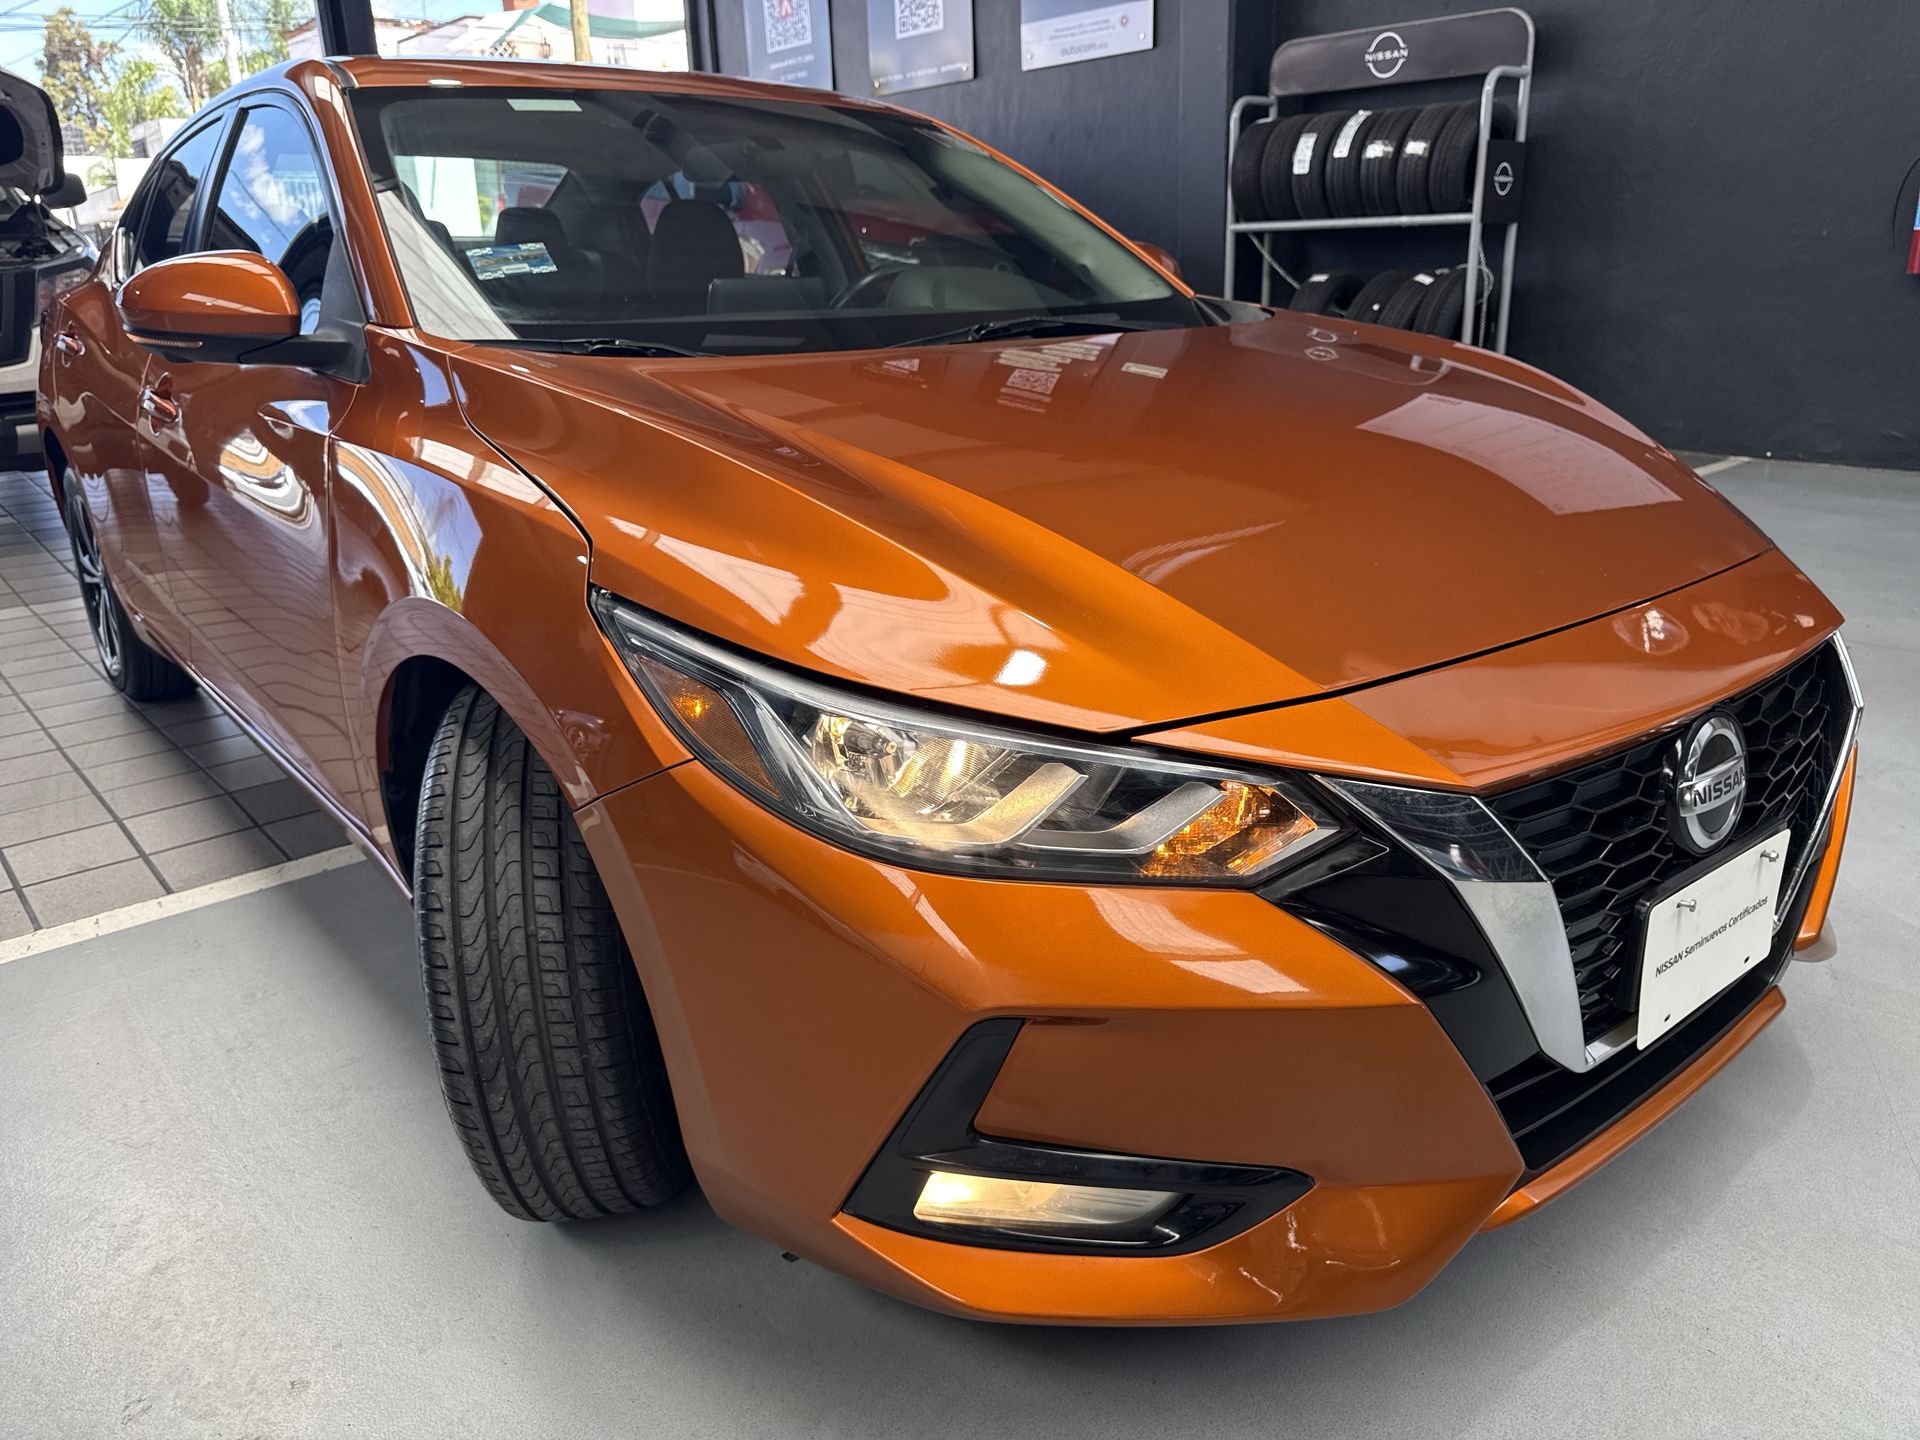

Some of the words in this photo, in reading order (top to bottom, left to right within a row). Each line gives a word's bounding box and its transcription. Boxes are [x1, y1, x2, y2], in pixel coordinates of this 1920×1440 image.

[1364, 49, 1409, 62] NISSAN
[1655, 951, 1684, 977] NISSAN
[1684, 923, 1728, 958] Seminuevos
[1728, 896, 1768, 928] Certificados
